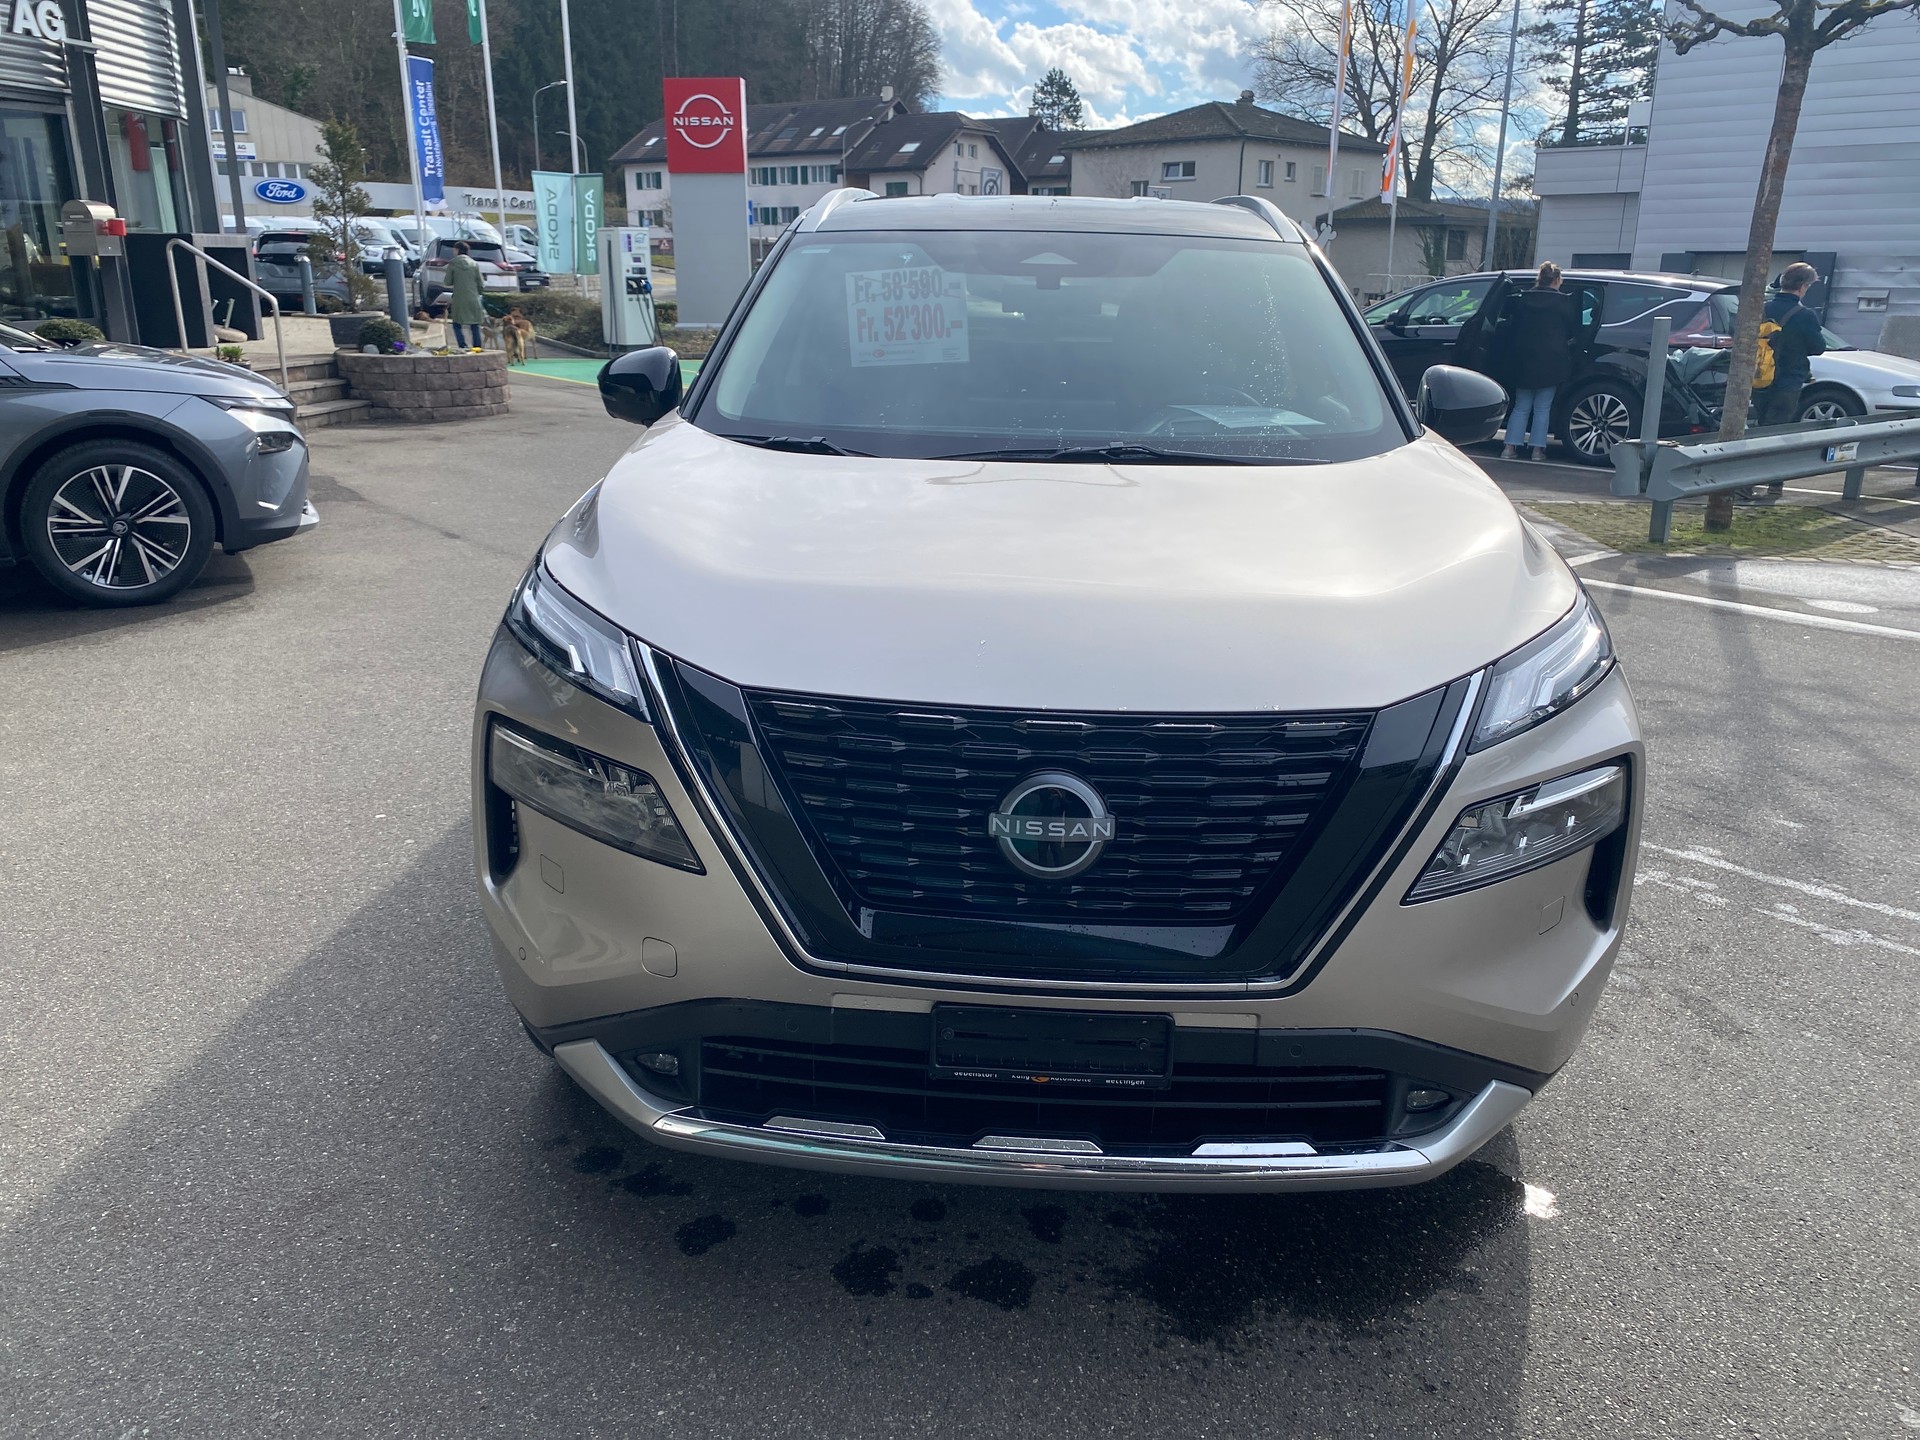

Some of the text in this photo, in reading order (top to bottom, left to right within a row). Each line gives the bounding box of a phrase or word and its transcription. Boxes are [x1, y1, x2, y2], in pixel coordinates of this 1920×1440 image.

[12, 0, 67, 41] AG
[415, 80, 436, 177] Transit Center
[673, 116, 734, 126] NISSAN
[265, 182, 297, 198] Ford
[464, 193, 507, 209] Transt
[854, 274, 877, 303] Fr.
[856, 308, 879, 343] Fr.
[992, 816, 1111, 837] NISSAN
